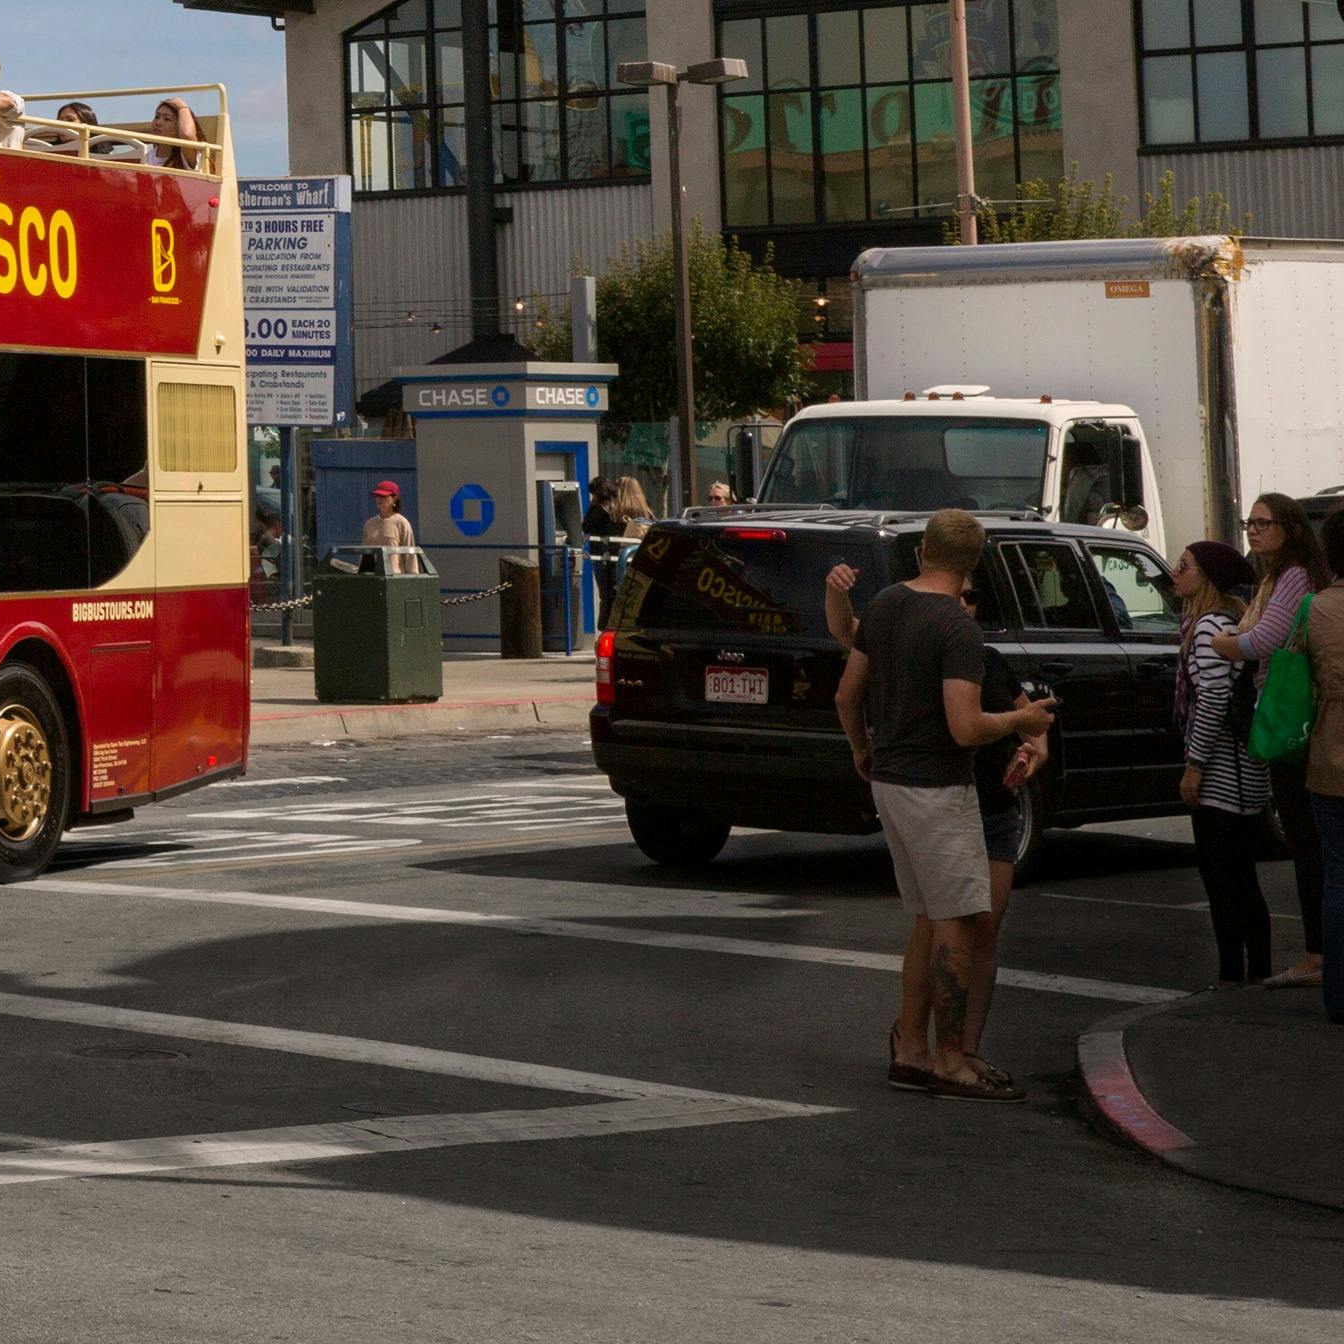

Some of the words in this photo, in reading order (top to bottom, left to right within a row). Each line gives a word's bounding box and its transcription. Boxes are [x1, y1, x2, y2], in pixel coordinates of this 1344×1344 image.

[249, 183, 292, 191] WELCOME
[239, 190, 291, 206] sherman's
[296, 182, 329, 205] Wharf
[255, 220, 262, 233] 3
[264, 220, 298, 233] HOURS
[300, 219, 324, 232] FREE
[247, 237, 308, 250] PARKING
[1110, 285, 1144, 293] OMEGA
[292, 320, 315, 328] EACH
[317, 319, 331, 328] 20
[292, 331, 331, 339] MINUTES
[261, 349, 285, 357] DAILY
[288, 350, 331, 358] MAXIMUM
[246, 370, 278, 379] cipating
[280, 370, 327, 378] Restaurants
[259, 380, 305, 388] Crabstands
[418, 389, 488, 406] CHASE
[535, 387, 585, 404] CHASE
[72, 600, 153, 622] BIGBUSTOURS.COM
[717, 650, 745, 663] Jeep
